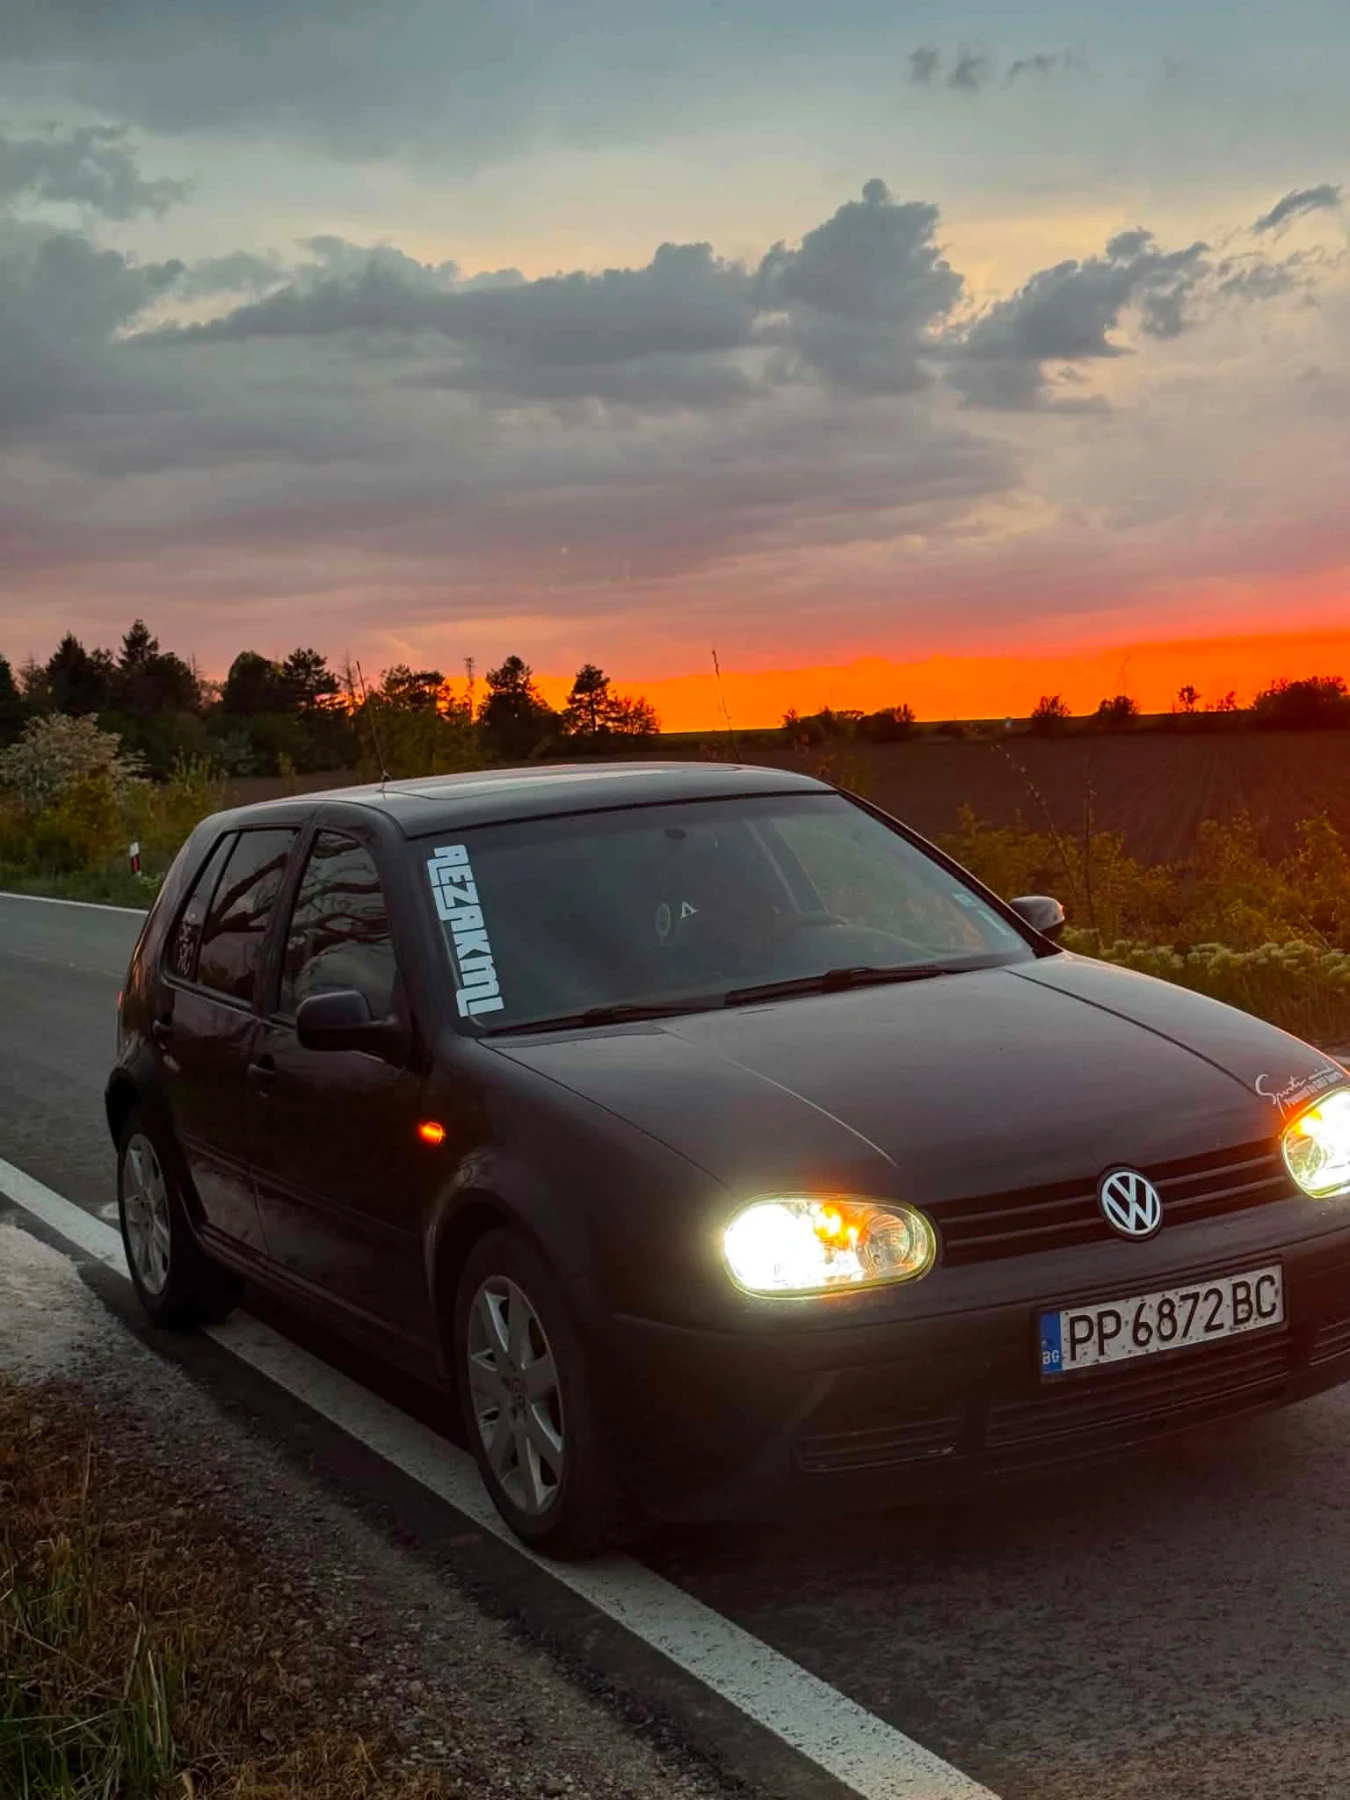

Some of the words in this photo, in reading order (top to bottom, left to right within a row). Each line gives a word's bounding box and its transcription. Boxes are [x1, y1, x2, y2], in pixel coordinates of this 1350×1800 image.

[1068, 1309, 1122, 1362] PP
[1131, 1287, 1225, 1347] 6872
[1231, 1274, 1277, 1326] BC
[1042, 1349, 1061, 1365] BG
